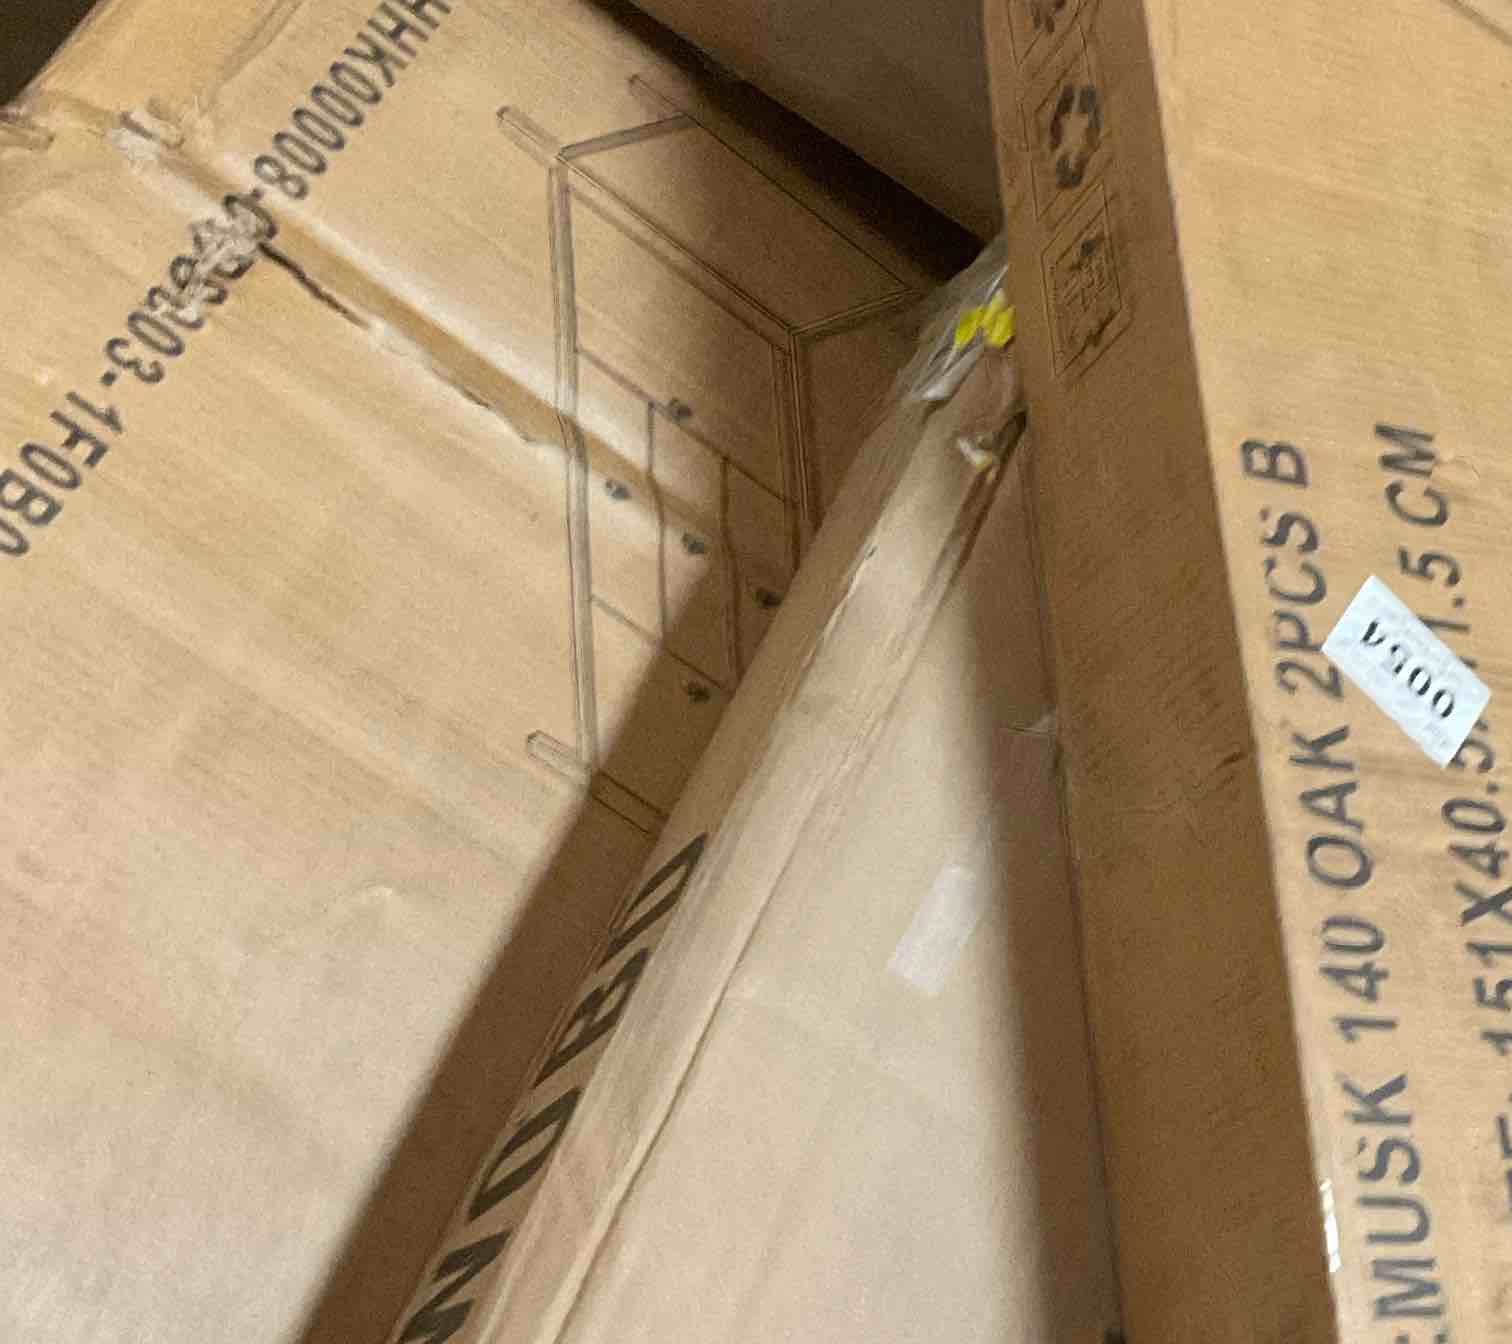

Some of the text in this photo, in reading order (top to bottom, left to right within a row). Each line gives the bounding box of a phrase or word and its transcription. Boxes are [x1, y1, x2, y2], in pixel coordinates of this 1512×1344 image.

[1241, 437, 1311, 487] B
[1375, 422, 1450, 528] CM
[1261, 509, 1346, 702] 2PCS
[1291, 725, 1373, 890] OAK
[1319, 915, 1397, 1040] 140
